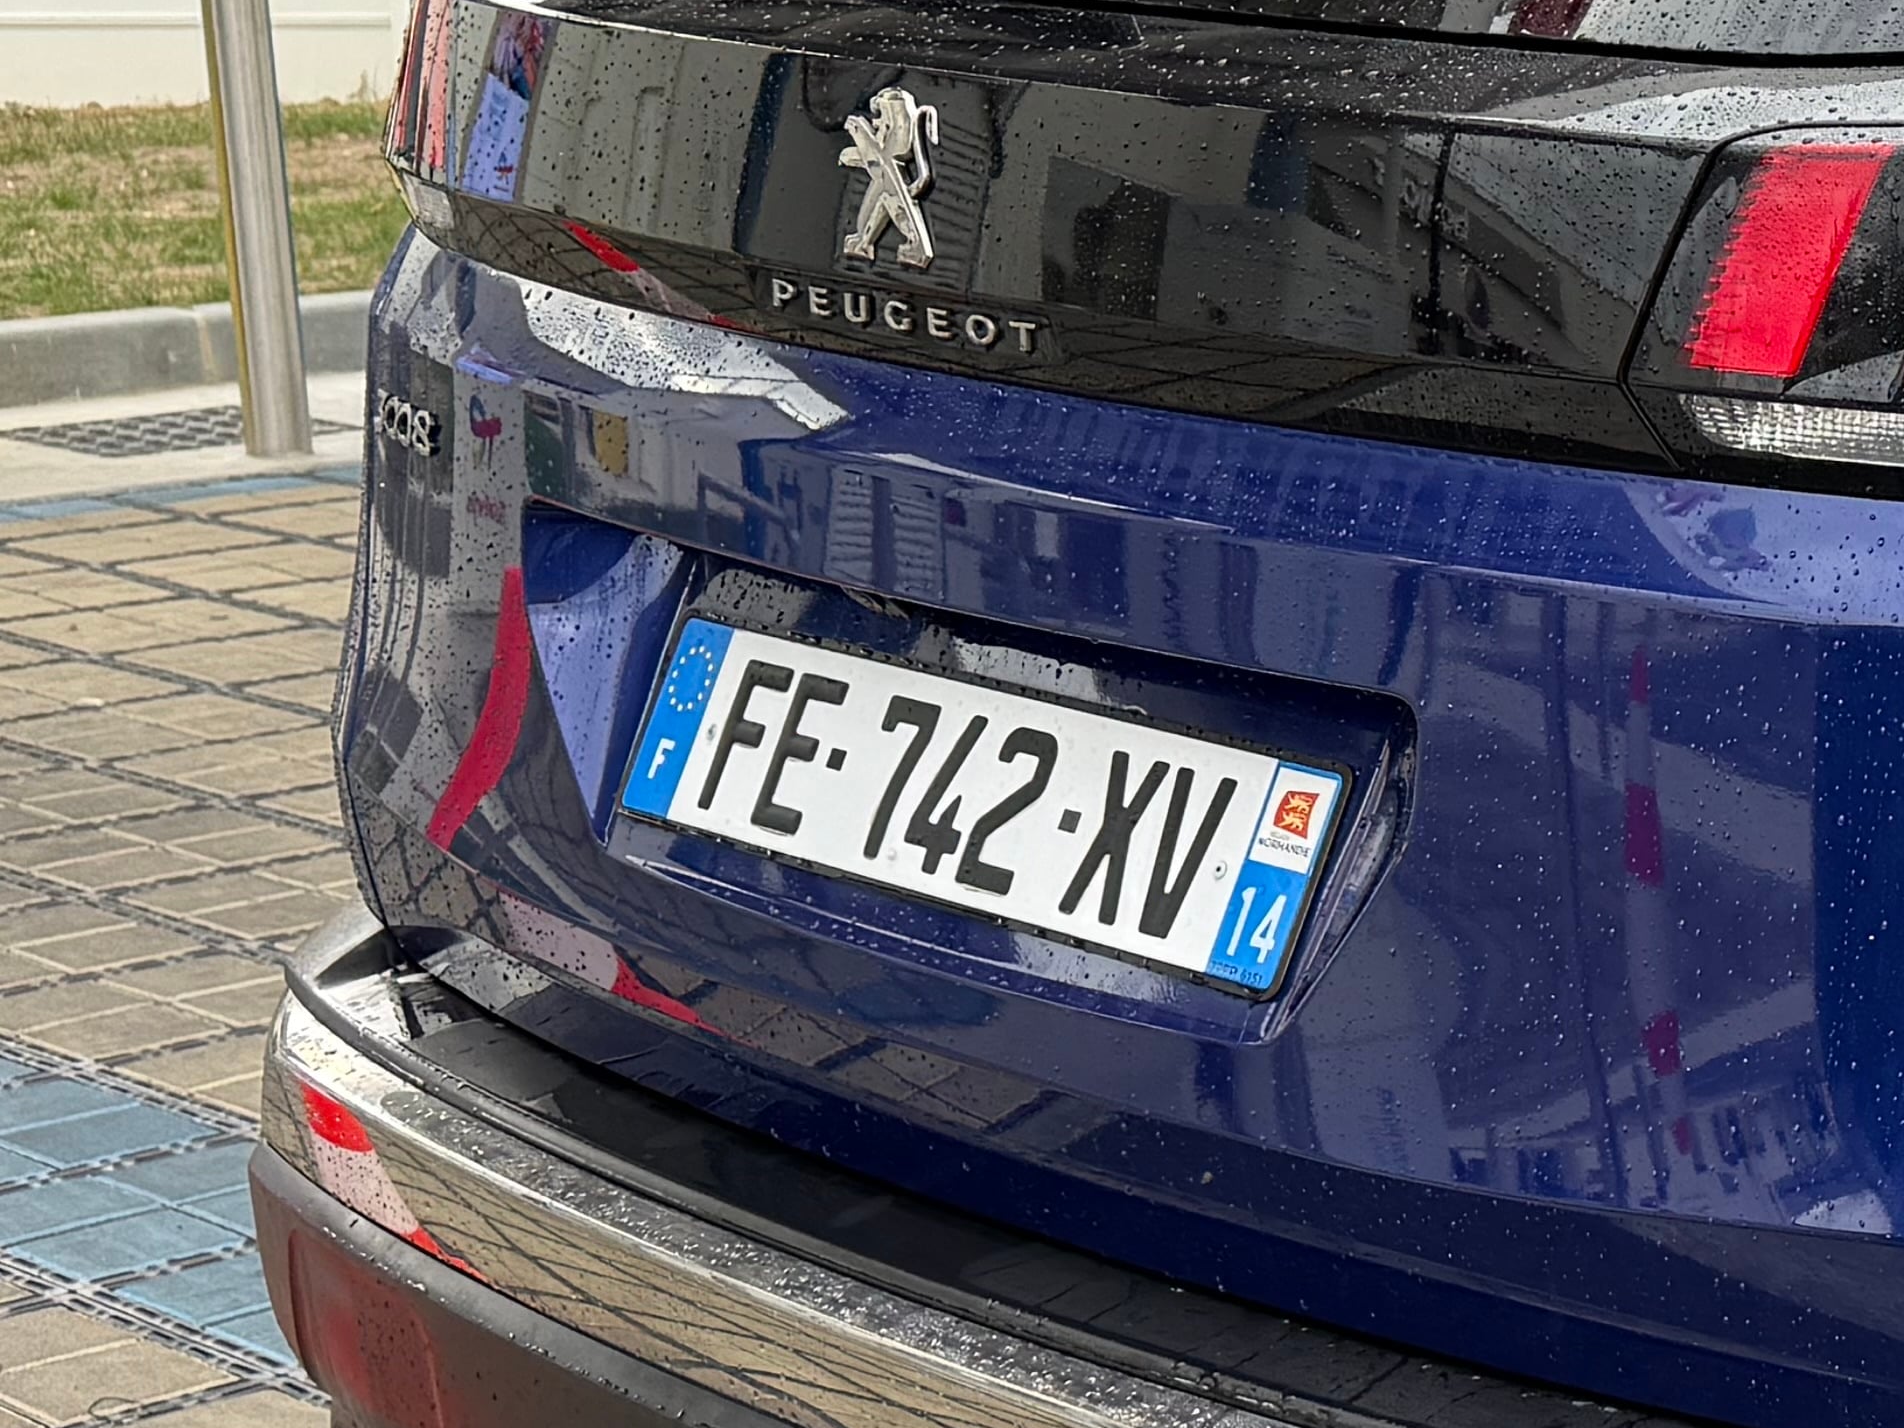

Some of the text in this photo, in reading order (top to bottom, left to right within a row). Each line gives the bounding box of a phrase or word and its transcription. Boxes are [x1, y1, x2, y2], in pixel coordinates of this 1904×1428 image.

[770, 277, 1039, 355] PEUGEOT
[646, 737, 676, 779] F
[1226, 886, 1288, 965] 14
